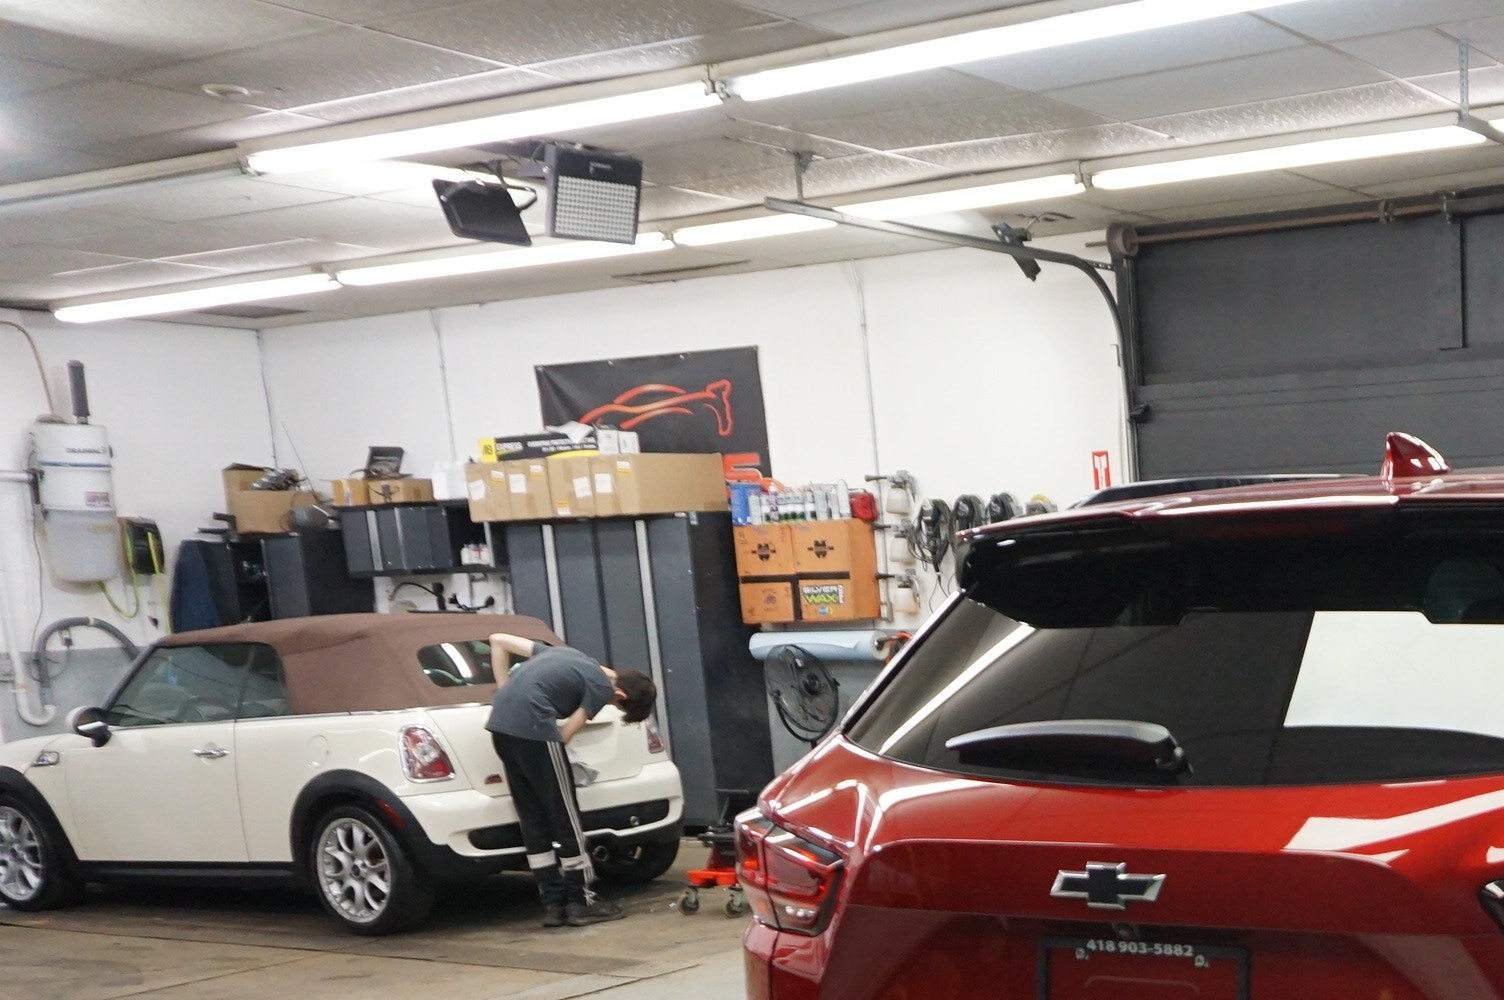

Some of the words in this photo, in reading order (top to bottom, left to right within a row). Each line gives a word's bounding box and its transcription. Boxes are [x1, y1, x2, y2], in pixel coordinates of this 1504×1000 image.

[802, 585, 838, 594] SILVER
[804, 593, 838, 604] WAX
[1086, 939, 1115, 952] 418
[1118, 940, 1194, 957] 903-5882
